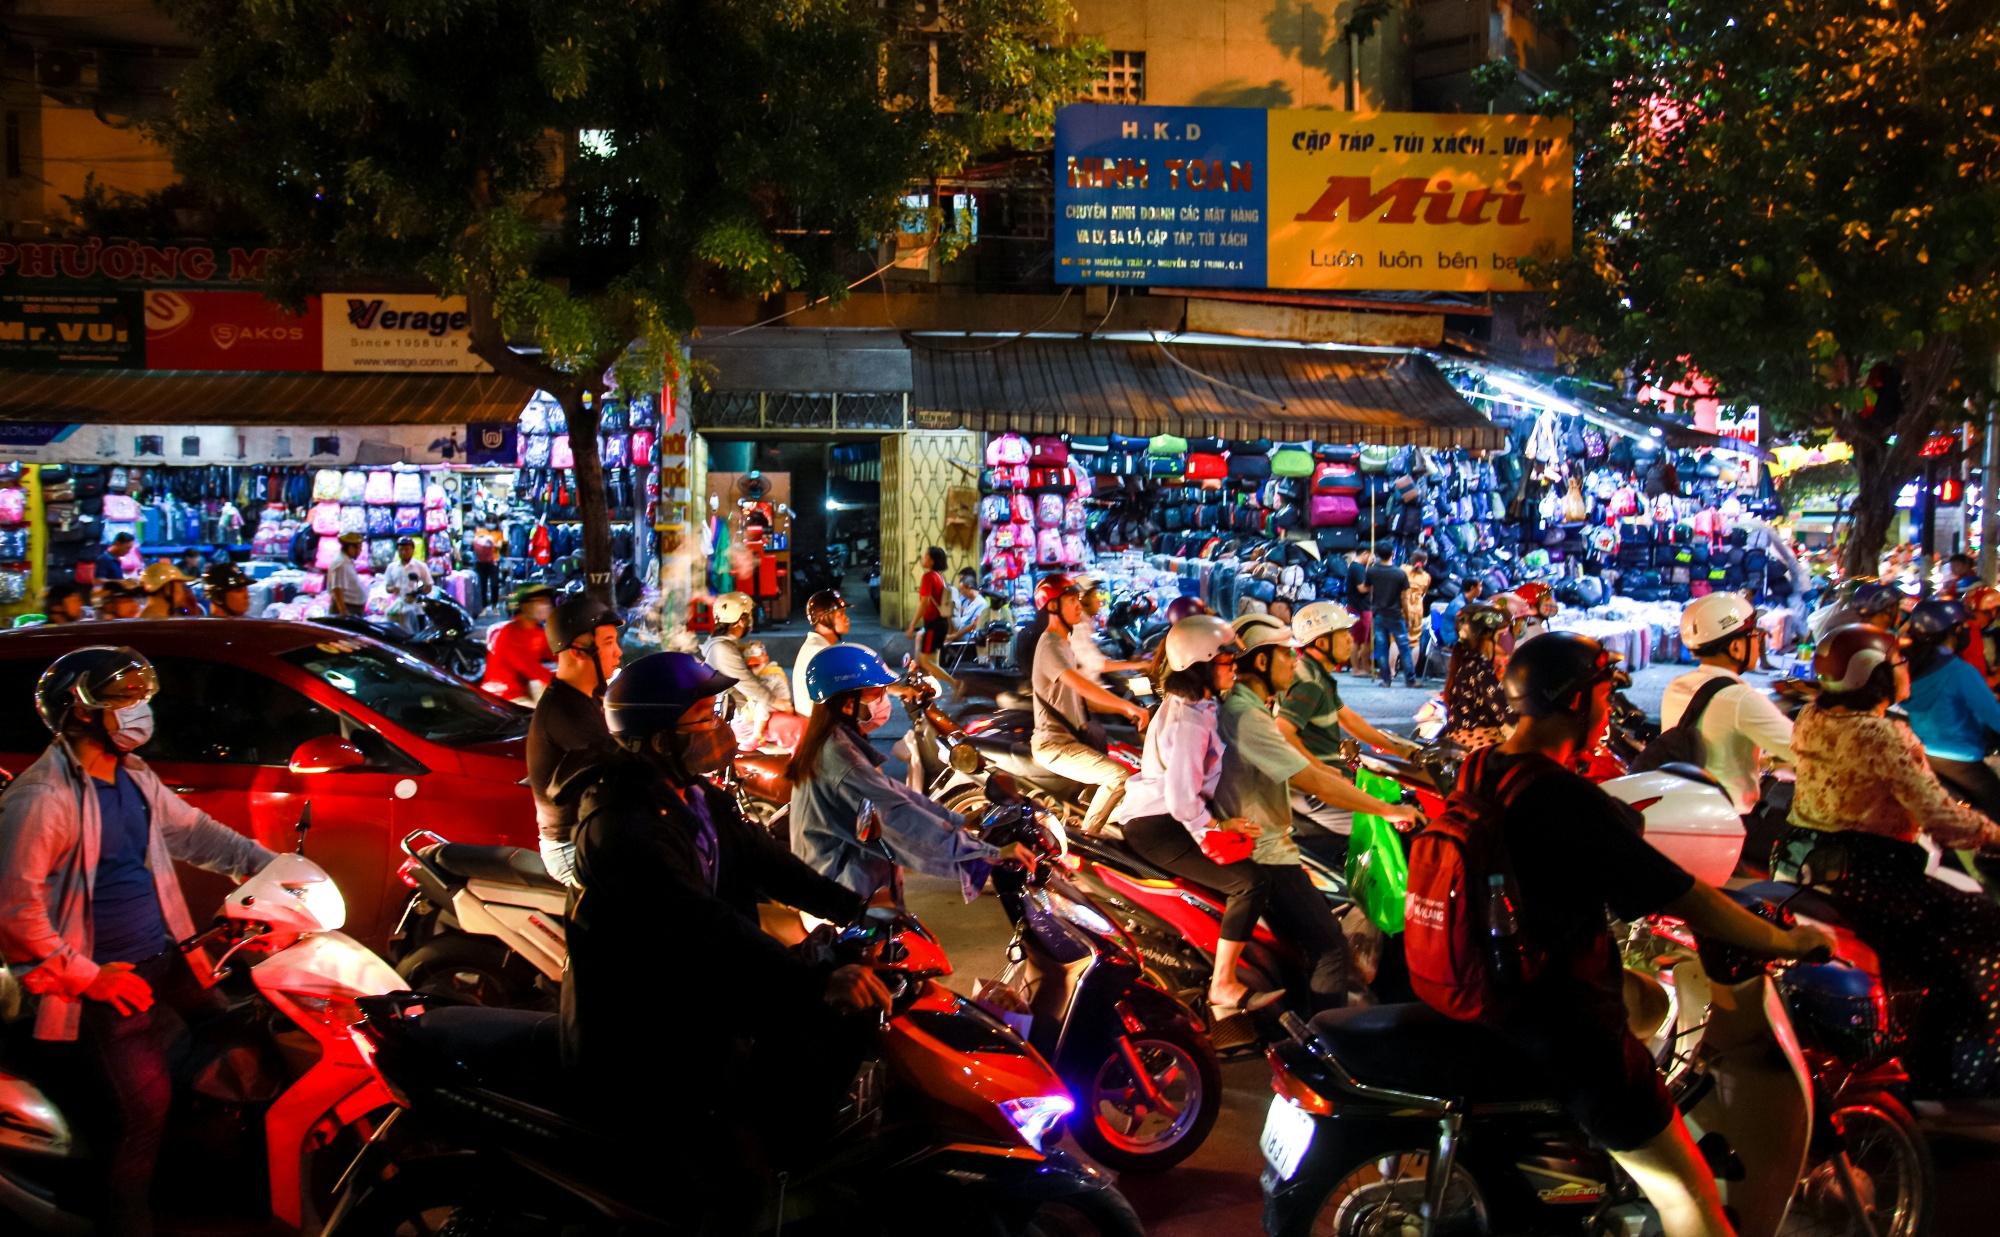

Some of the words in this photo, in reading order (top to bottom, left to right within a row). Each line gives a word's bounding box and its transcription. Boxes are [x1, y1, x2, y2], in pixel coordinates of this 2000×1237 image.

[1292, 130, 1331, 155] CẶP
[1339, 130, 1375, 153] TÁP
[1393, 132, 1424, 154] TÚI
[1431, 132, 1485, 155] XÁCH
[1504, 137, 1528, 155] VA
[1067, 155, 1149, 189] MINH
[1293, 175, 1530, 226] Miti
[1066, 203, 1107, 220] CHUYÊN
[1111, 205, 1136, 220] KINH
[1140, 206, 1175, 221] DOANH
[1180, 205, 1200, 221] CÁC
[1231, 206, 1259, 223] HÀNG
[1110, 229, 1125, 244] BA
[1220, 229, 1248, 247] XÁCH
[1310, 250, 1363, 267] Luôn
[1379, 250, 1422, 268] luôn
[1438, 251, 1478, 269] bên
[1493, 252, 1520, 275] bạ
[346, 299, 467, 337] Verage
[351, 338, 391, 347] Since
[396, 338, 430, 347] 1958
[353, 357, 459, 368] www.verage.com.vn
[589, 572, 611, 584] 177
